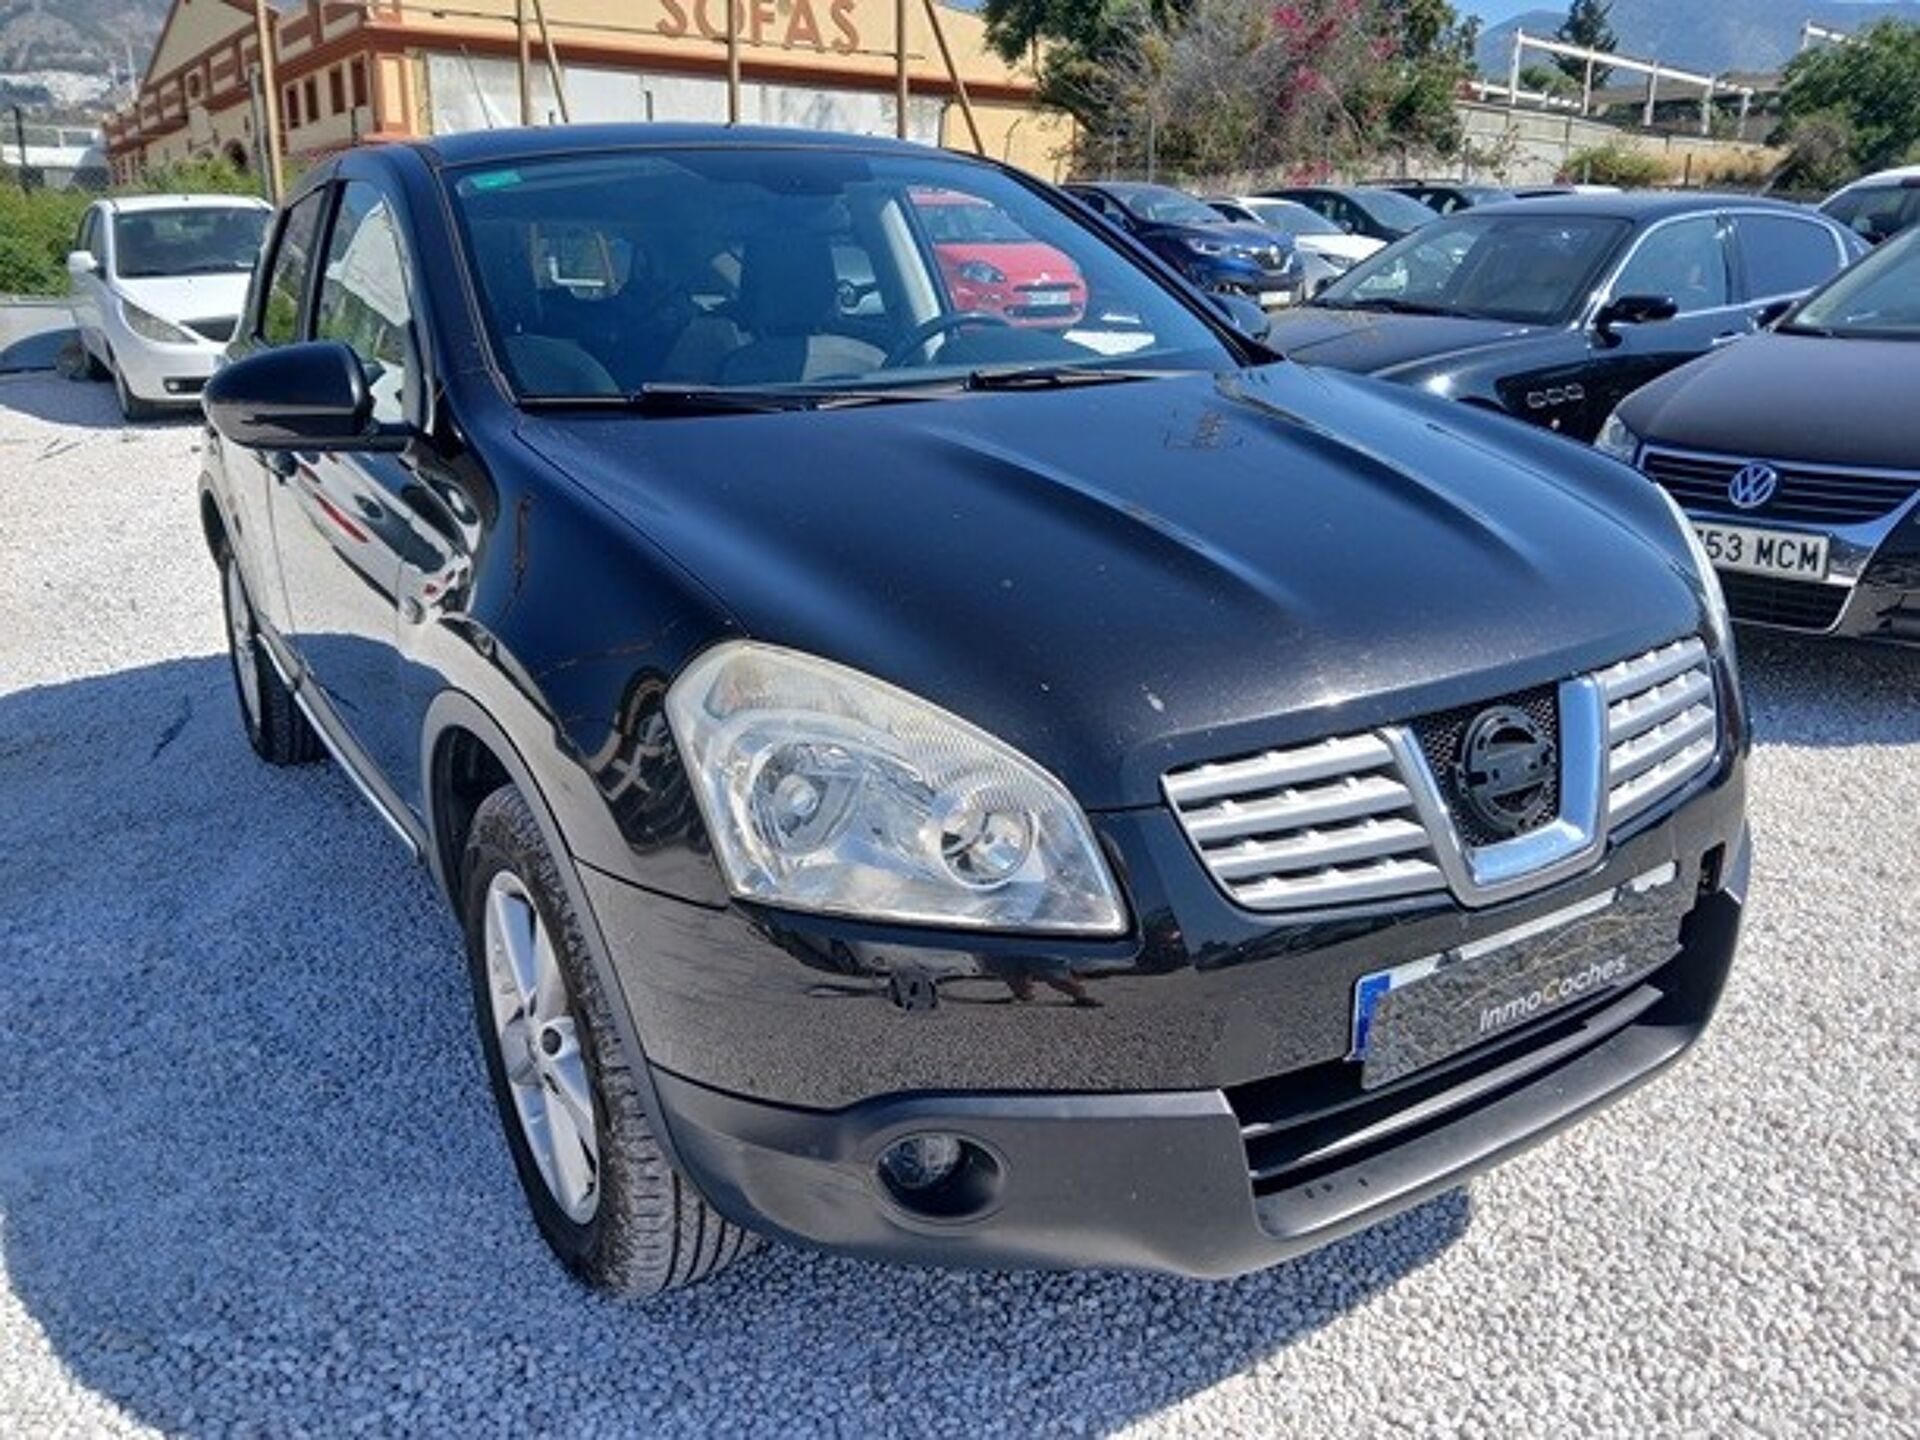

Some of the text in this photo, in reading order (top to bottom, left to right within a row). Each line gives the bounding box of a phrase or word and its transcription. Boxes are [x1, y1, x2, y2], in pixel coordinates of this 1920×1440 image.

[656, 0, 860, 56] SOFAS
[1696, 529, 1820, 571] 53 MCM
[1479, 954, 1628, 1033] InmoCoches
